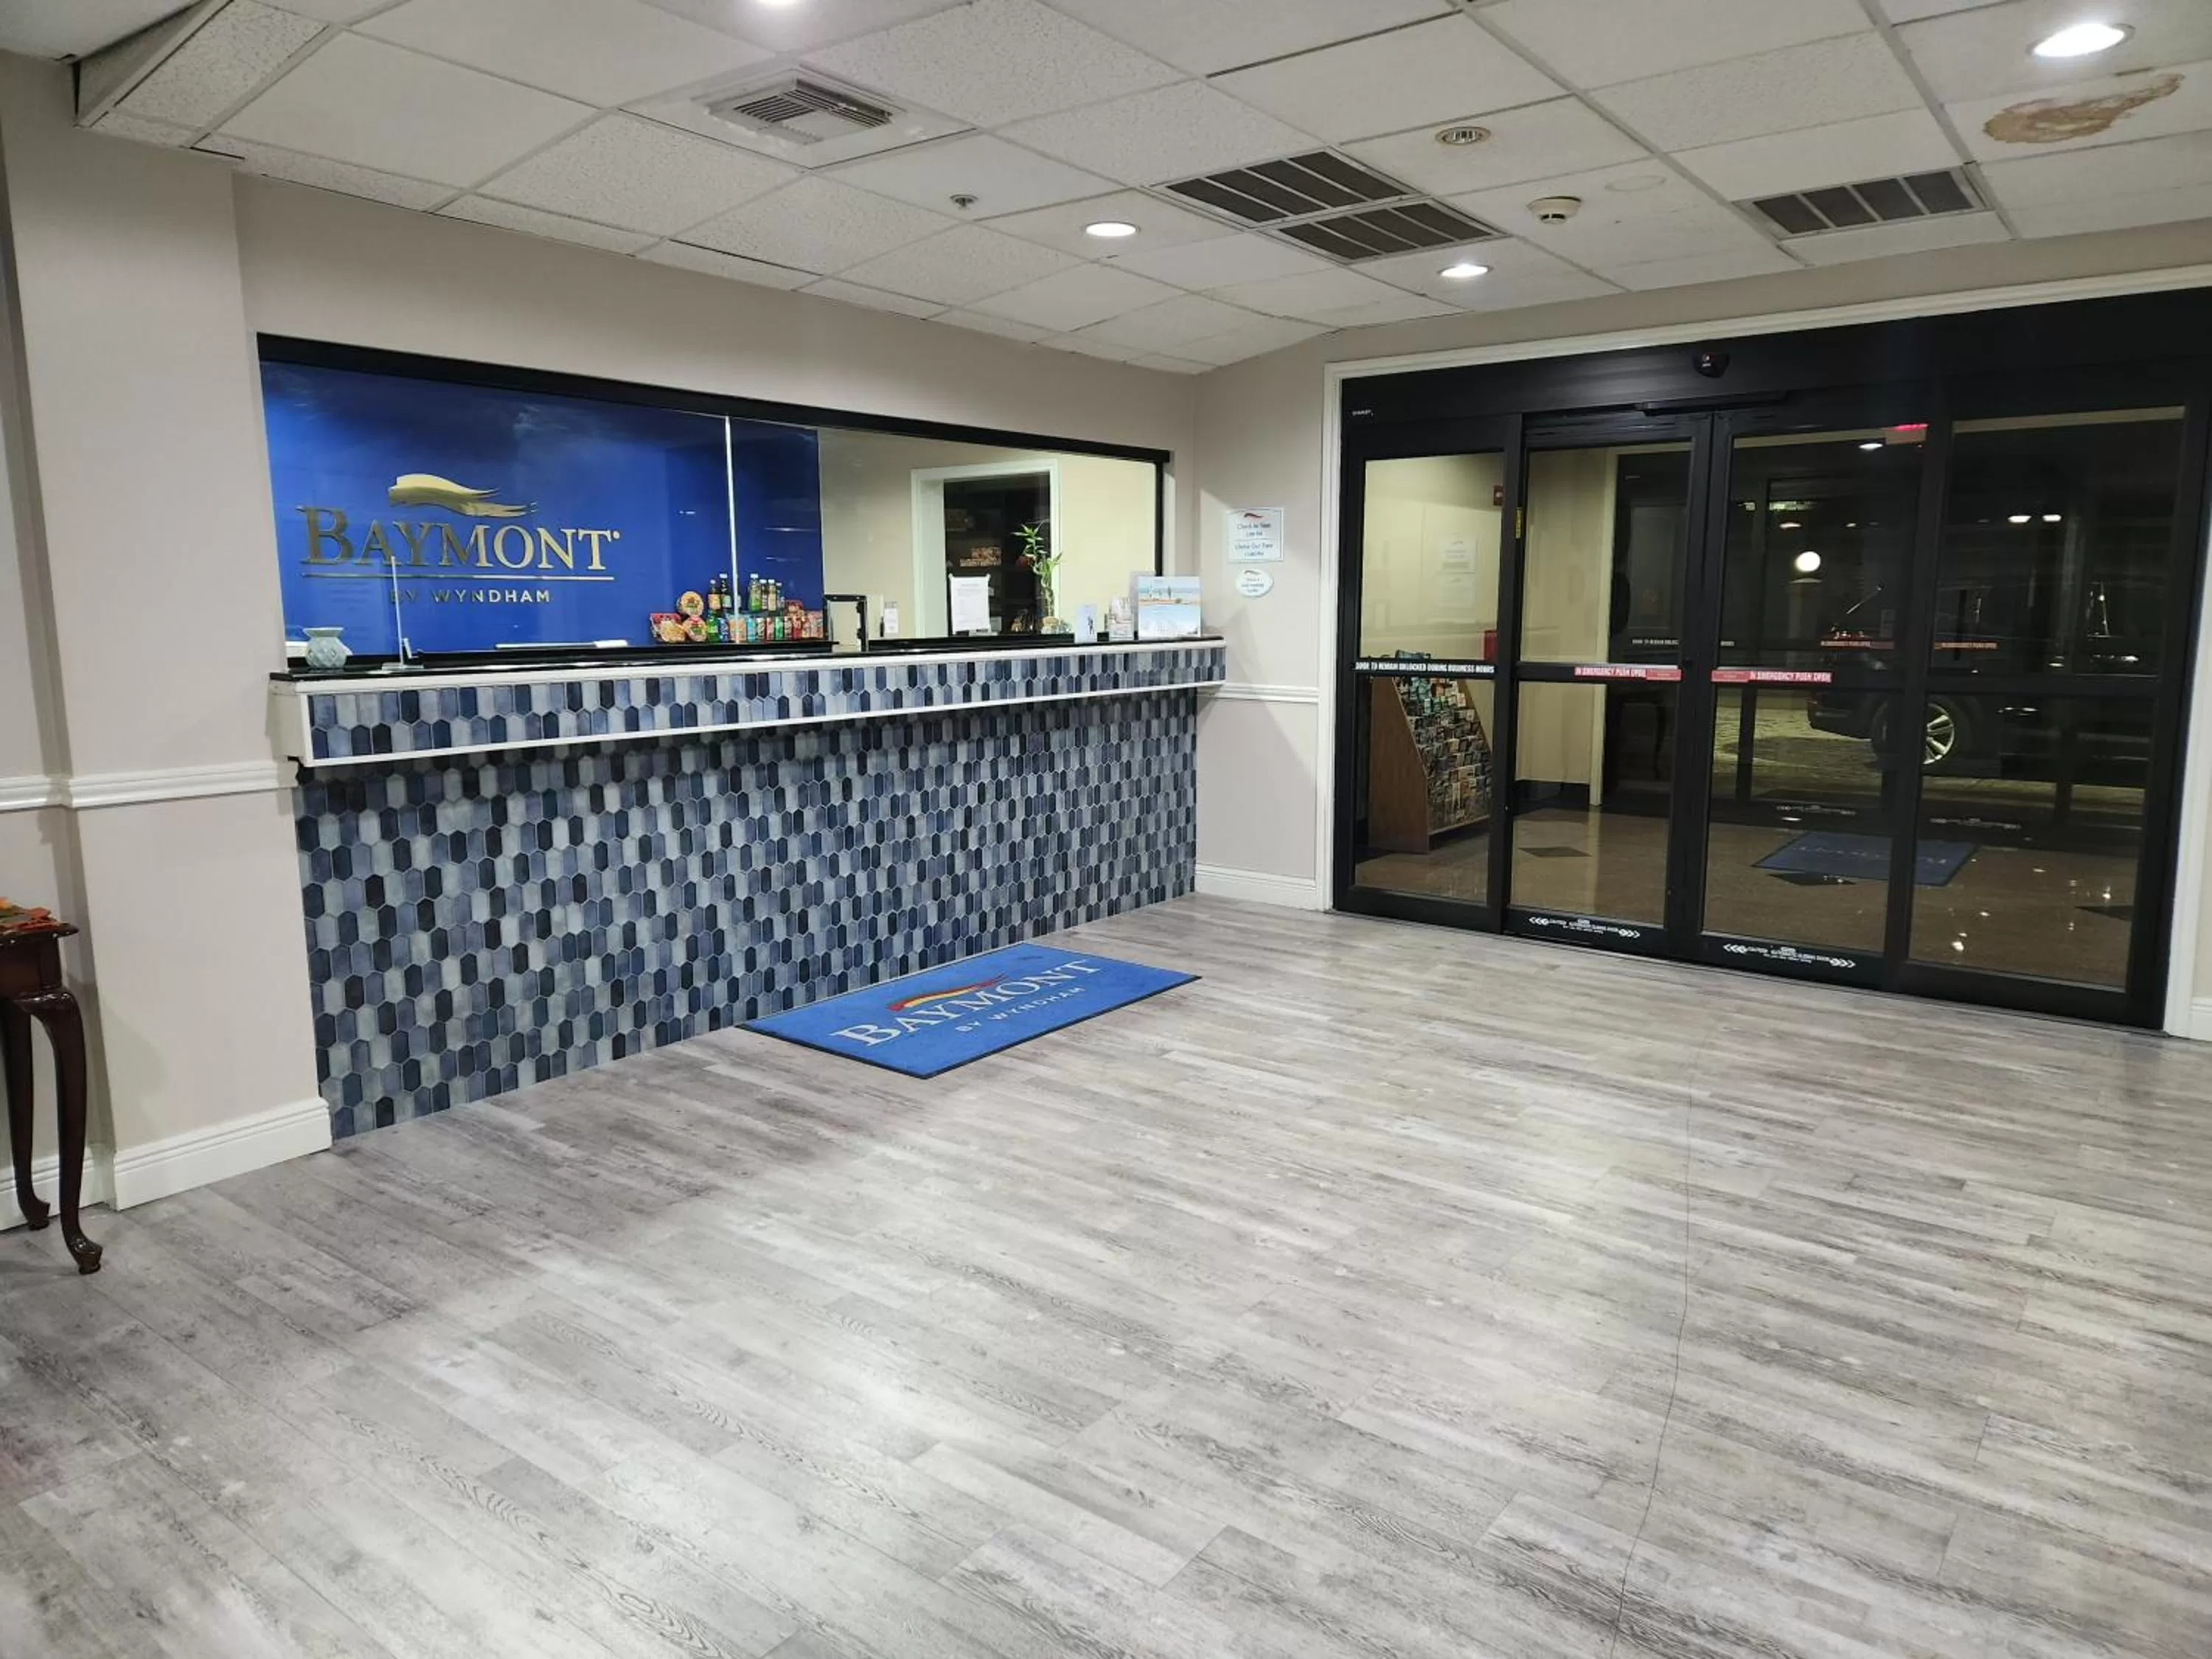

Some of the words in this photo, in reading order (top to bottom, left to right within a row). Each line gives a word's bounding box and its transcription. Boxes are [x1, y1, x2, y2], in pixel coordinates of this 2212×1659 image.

[296, 506, 613, 570] BAYMONT
[391, 589, 416, 602] BY
[433, 589, 550, 602] WYNDHAM
[830, 959, 1100, 1046] BAYMONT
[955, 1020, 982, 1032] BY
[987, 987, 1086, 1020] WYNDHAM
